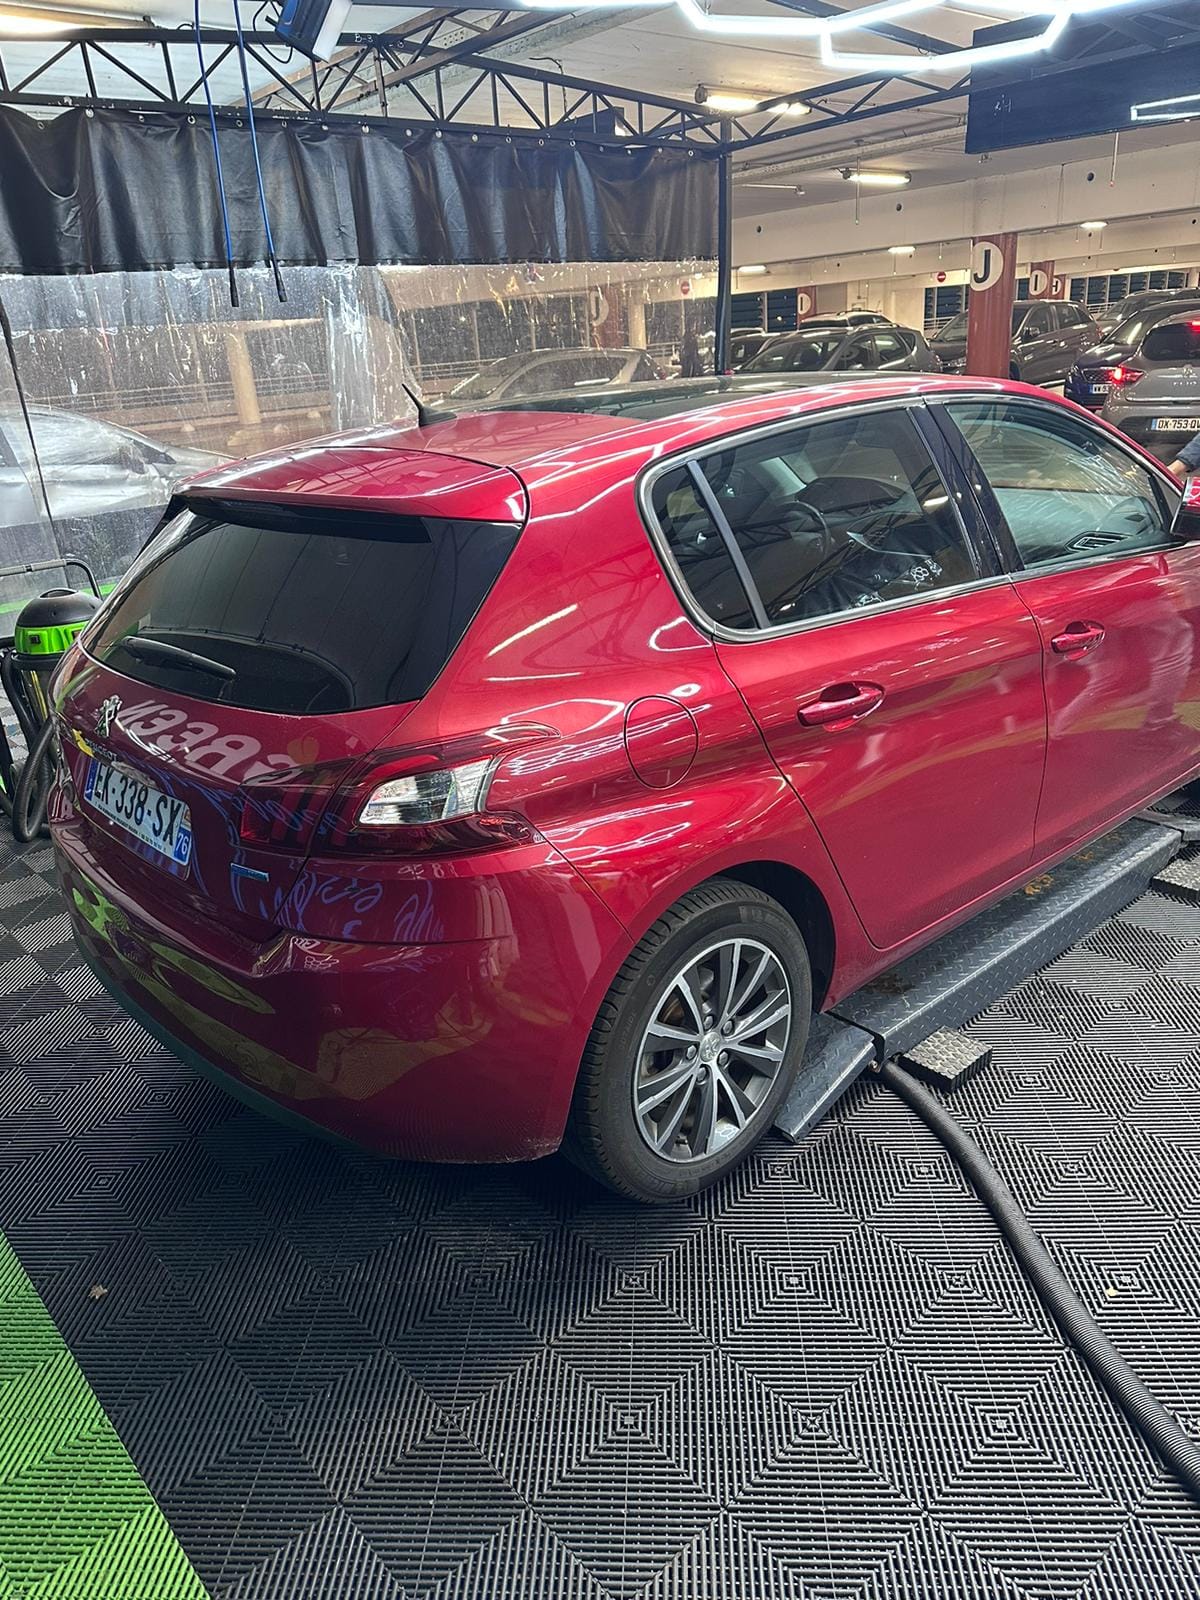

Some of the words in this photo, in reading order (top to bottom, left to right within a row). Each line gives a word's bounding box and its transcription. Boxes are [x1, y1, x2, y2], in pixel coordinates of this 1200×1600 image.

[973, 248, 992, 284] J
[94, 761, 182, 847] EK-338-SX
[176, 833, 190, 856] 76
